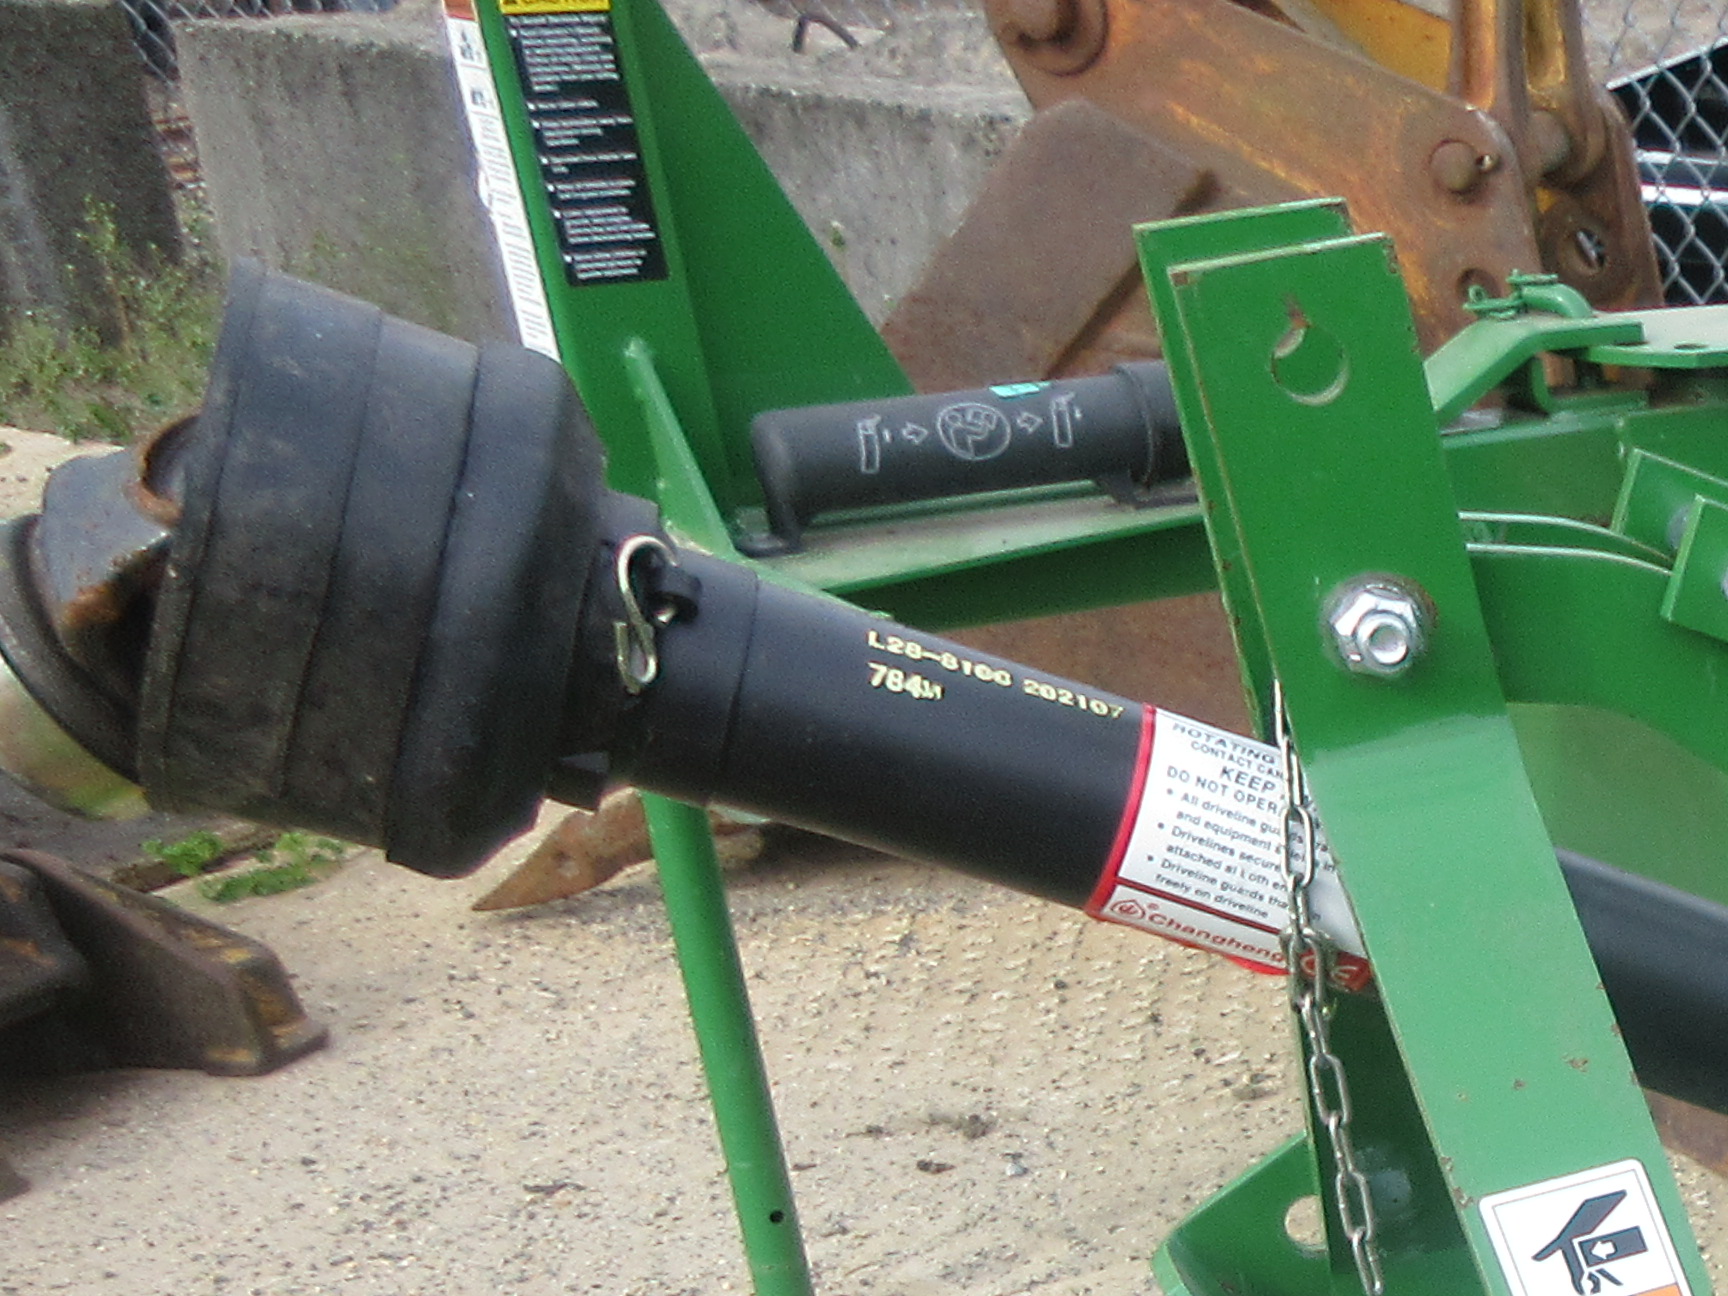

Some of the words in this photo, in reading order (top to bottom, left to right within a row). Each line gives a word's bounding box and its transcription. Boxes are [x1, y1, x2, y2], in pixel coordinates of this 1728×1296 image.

[1021, 678, 1125, 720] 202107
[1191, 740, 1252, 769] CONTACT
[1167, 765, 1190, 783] DO
[1195, 776, 1228, 796] NOT
[1234, 789, 1282, 817] OPER
[1220, 766, 1276, 793] KEEP
[1201, 800, 1257, 827] driveline
[1171, 825, 1236, 857] Drivelines
[1176, 811, 1201, 826] and
[1204, 821, 1271, 851] equipment
[1166, 844, 1222, 870] attached
[1160, 858, 1218, 885] Driveline
[1268, 895, 1289, 909] tha
[1214, 895, 1269, 918] driveline
